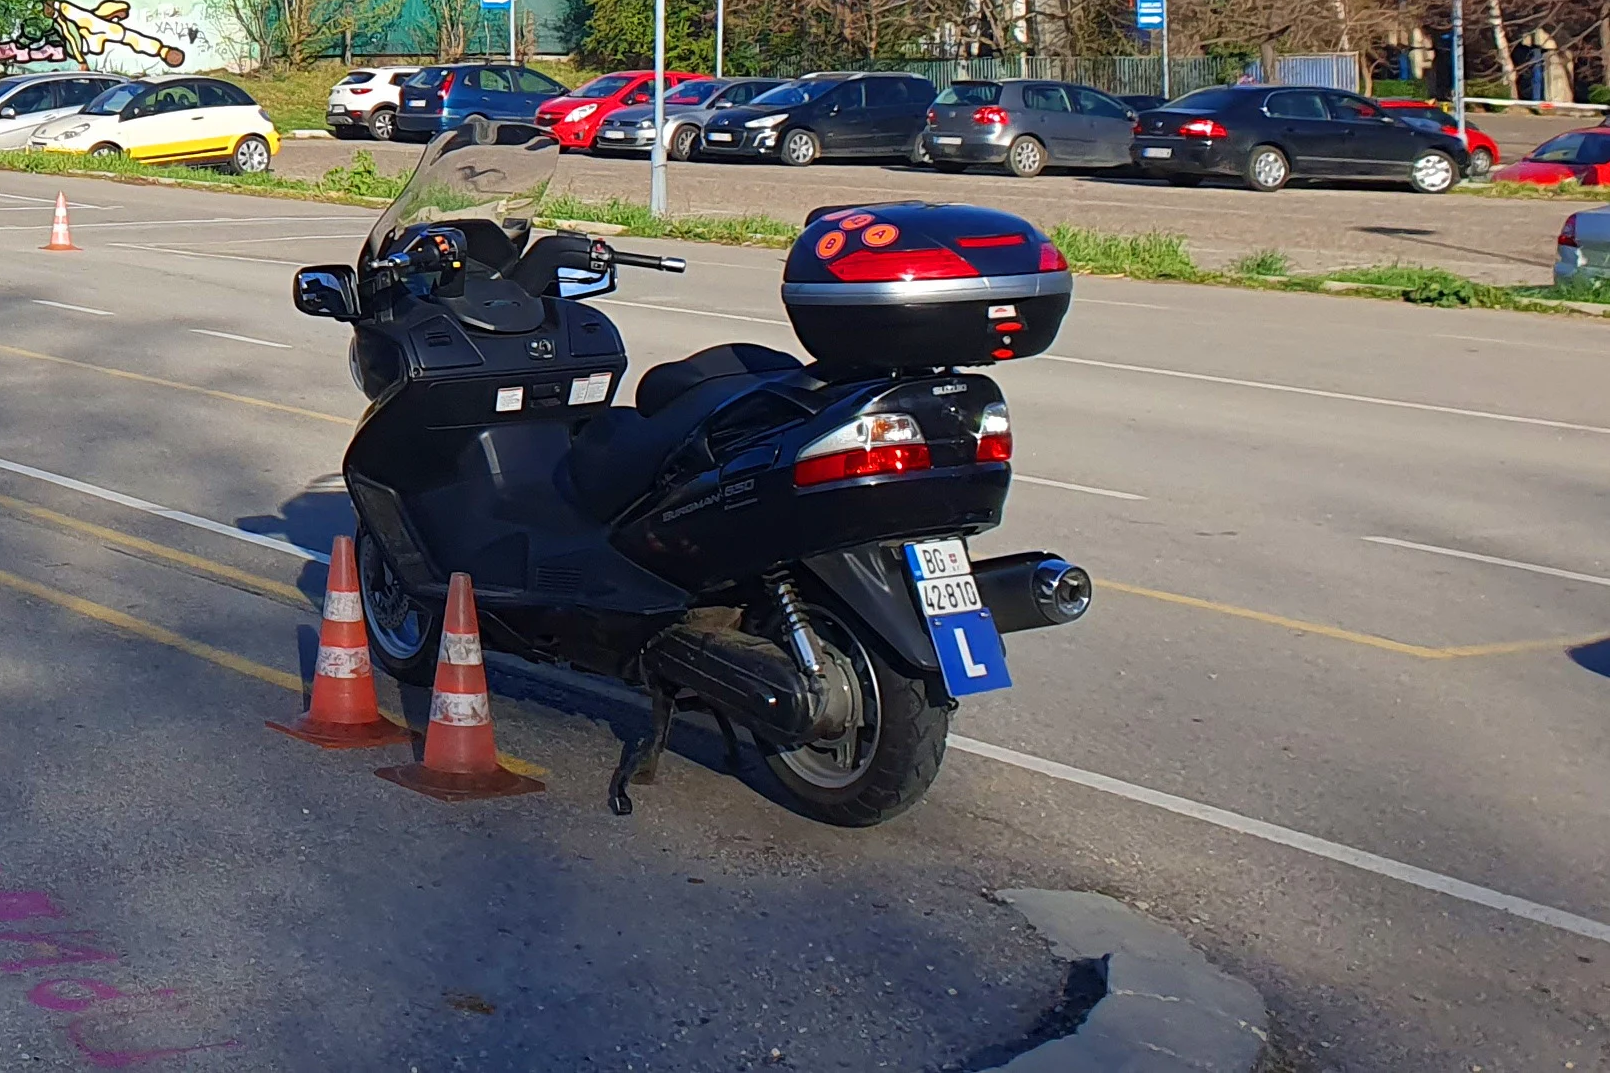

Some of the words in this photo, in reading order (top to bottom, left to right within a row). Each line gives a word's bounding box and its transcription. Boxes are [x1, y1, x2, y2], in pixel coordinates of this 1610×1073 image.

[824, 237, 836, 250] B
[872, 229, 887, 240] A
[724, 478, 755, 497] 650
[921, 548, 946, 575] BG
[953, 627, 988, 678] L
